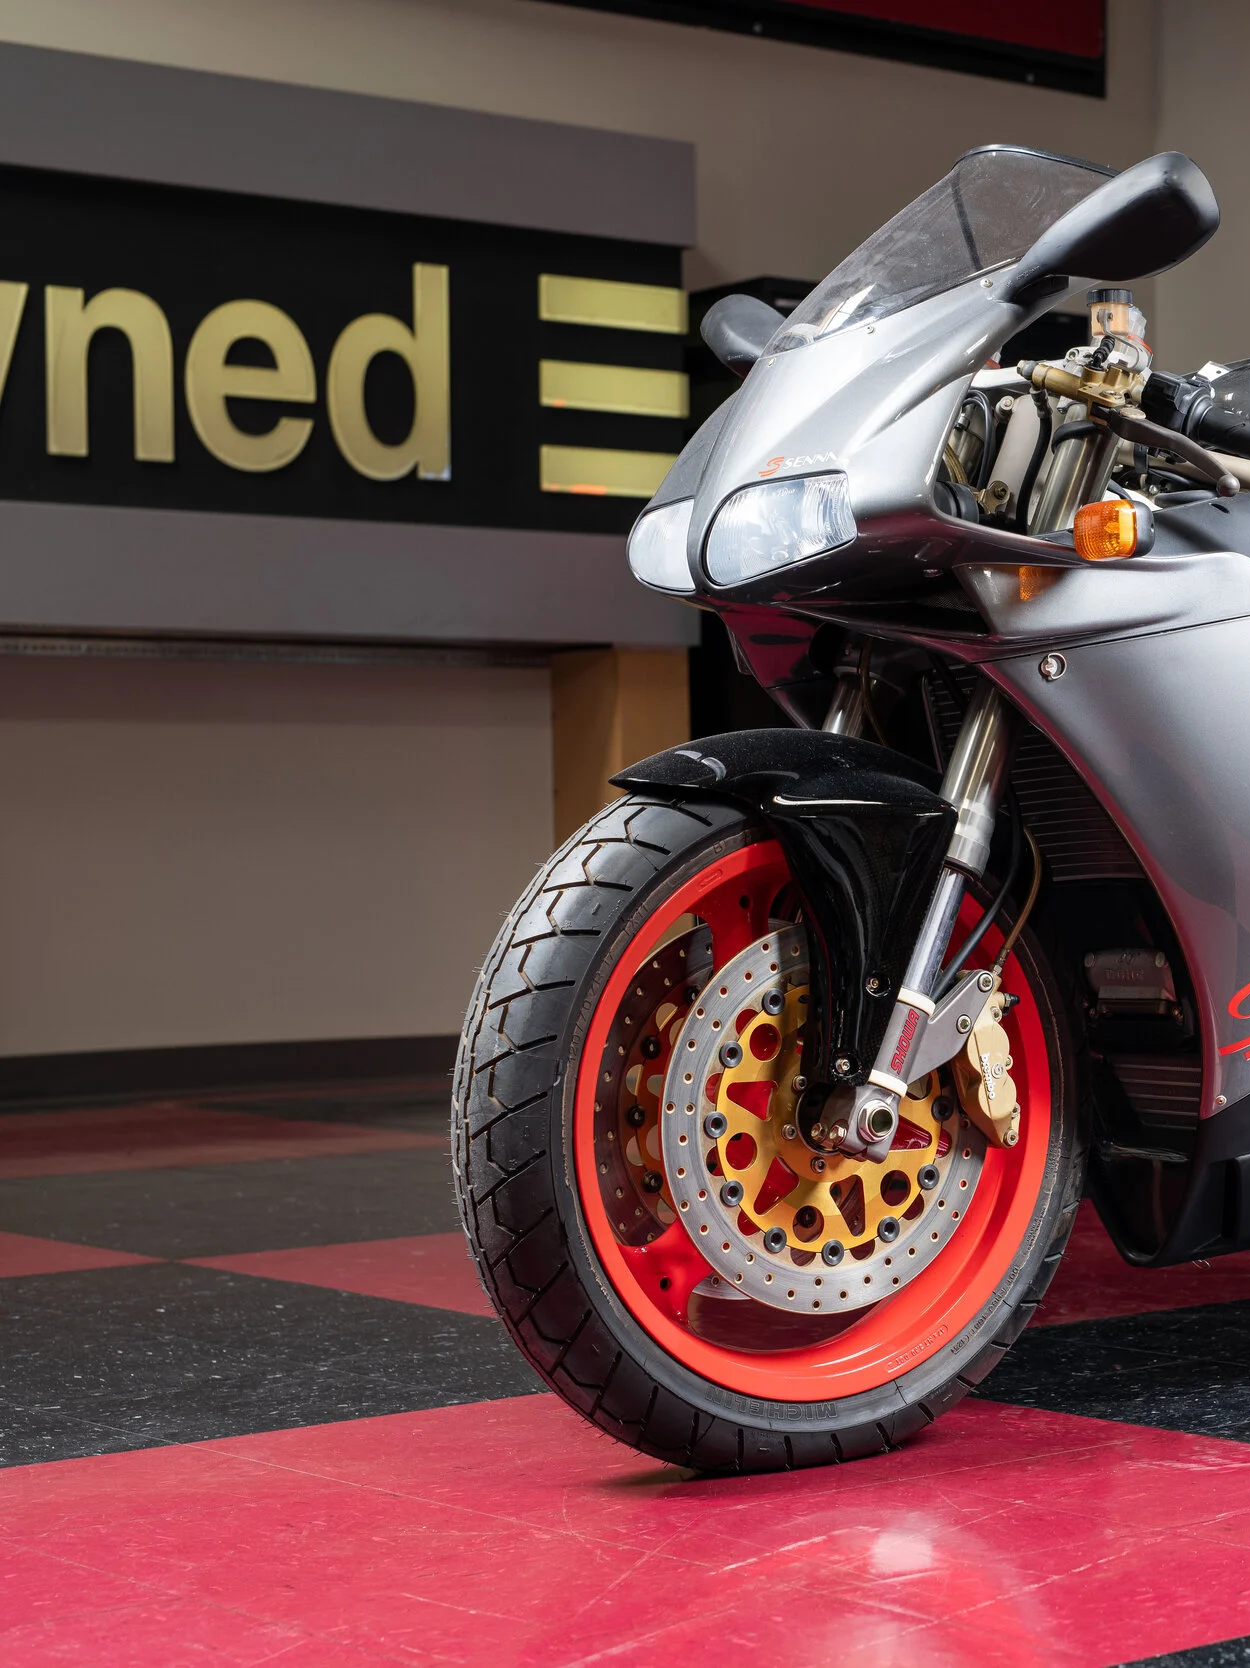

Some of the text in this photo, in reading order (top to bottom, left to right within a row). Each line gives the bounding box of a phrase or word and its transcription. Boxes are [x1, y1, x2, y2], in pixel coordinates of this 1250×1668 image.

[783, 451, 838, 470] SENNA
[890, 1008, 921, 1075] SHOWA
[704, 1384, 839, 1421] MICHELIN
